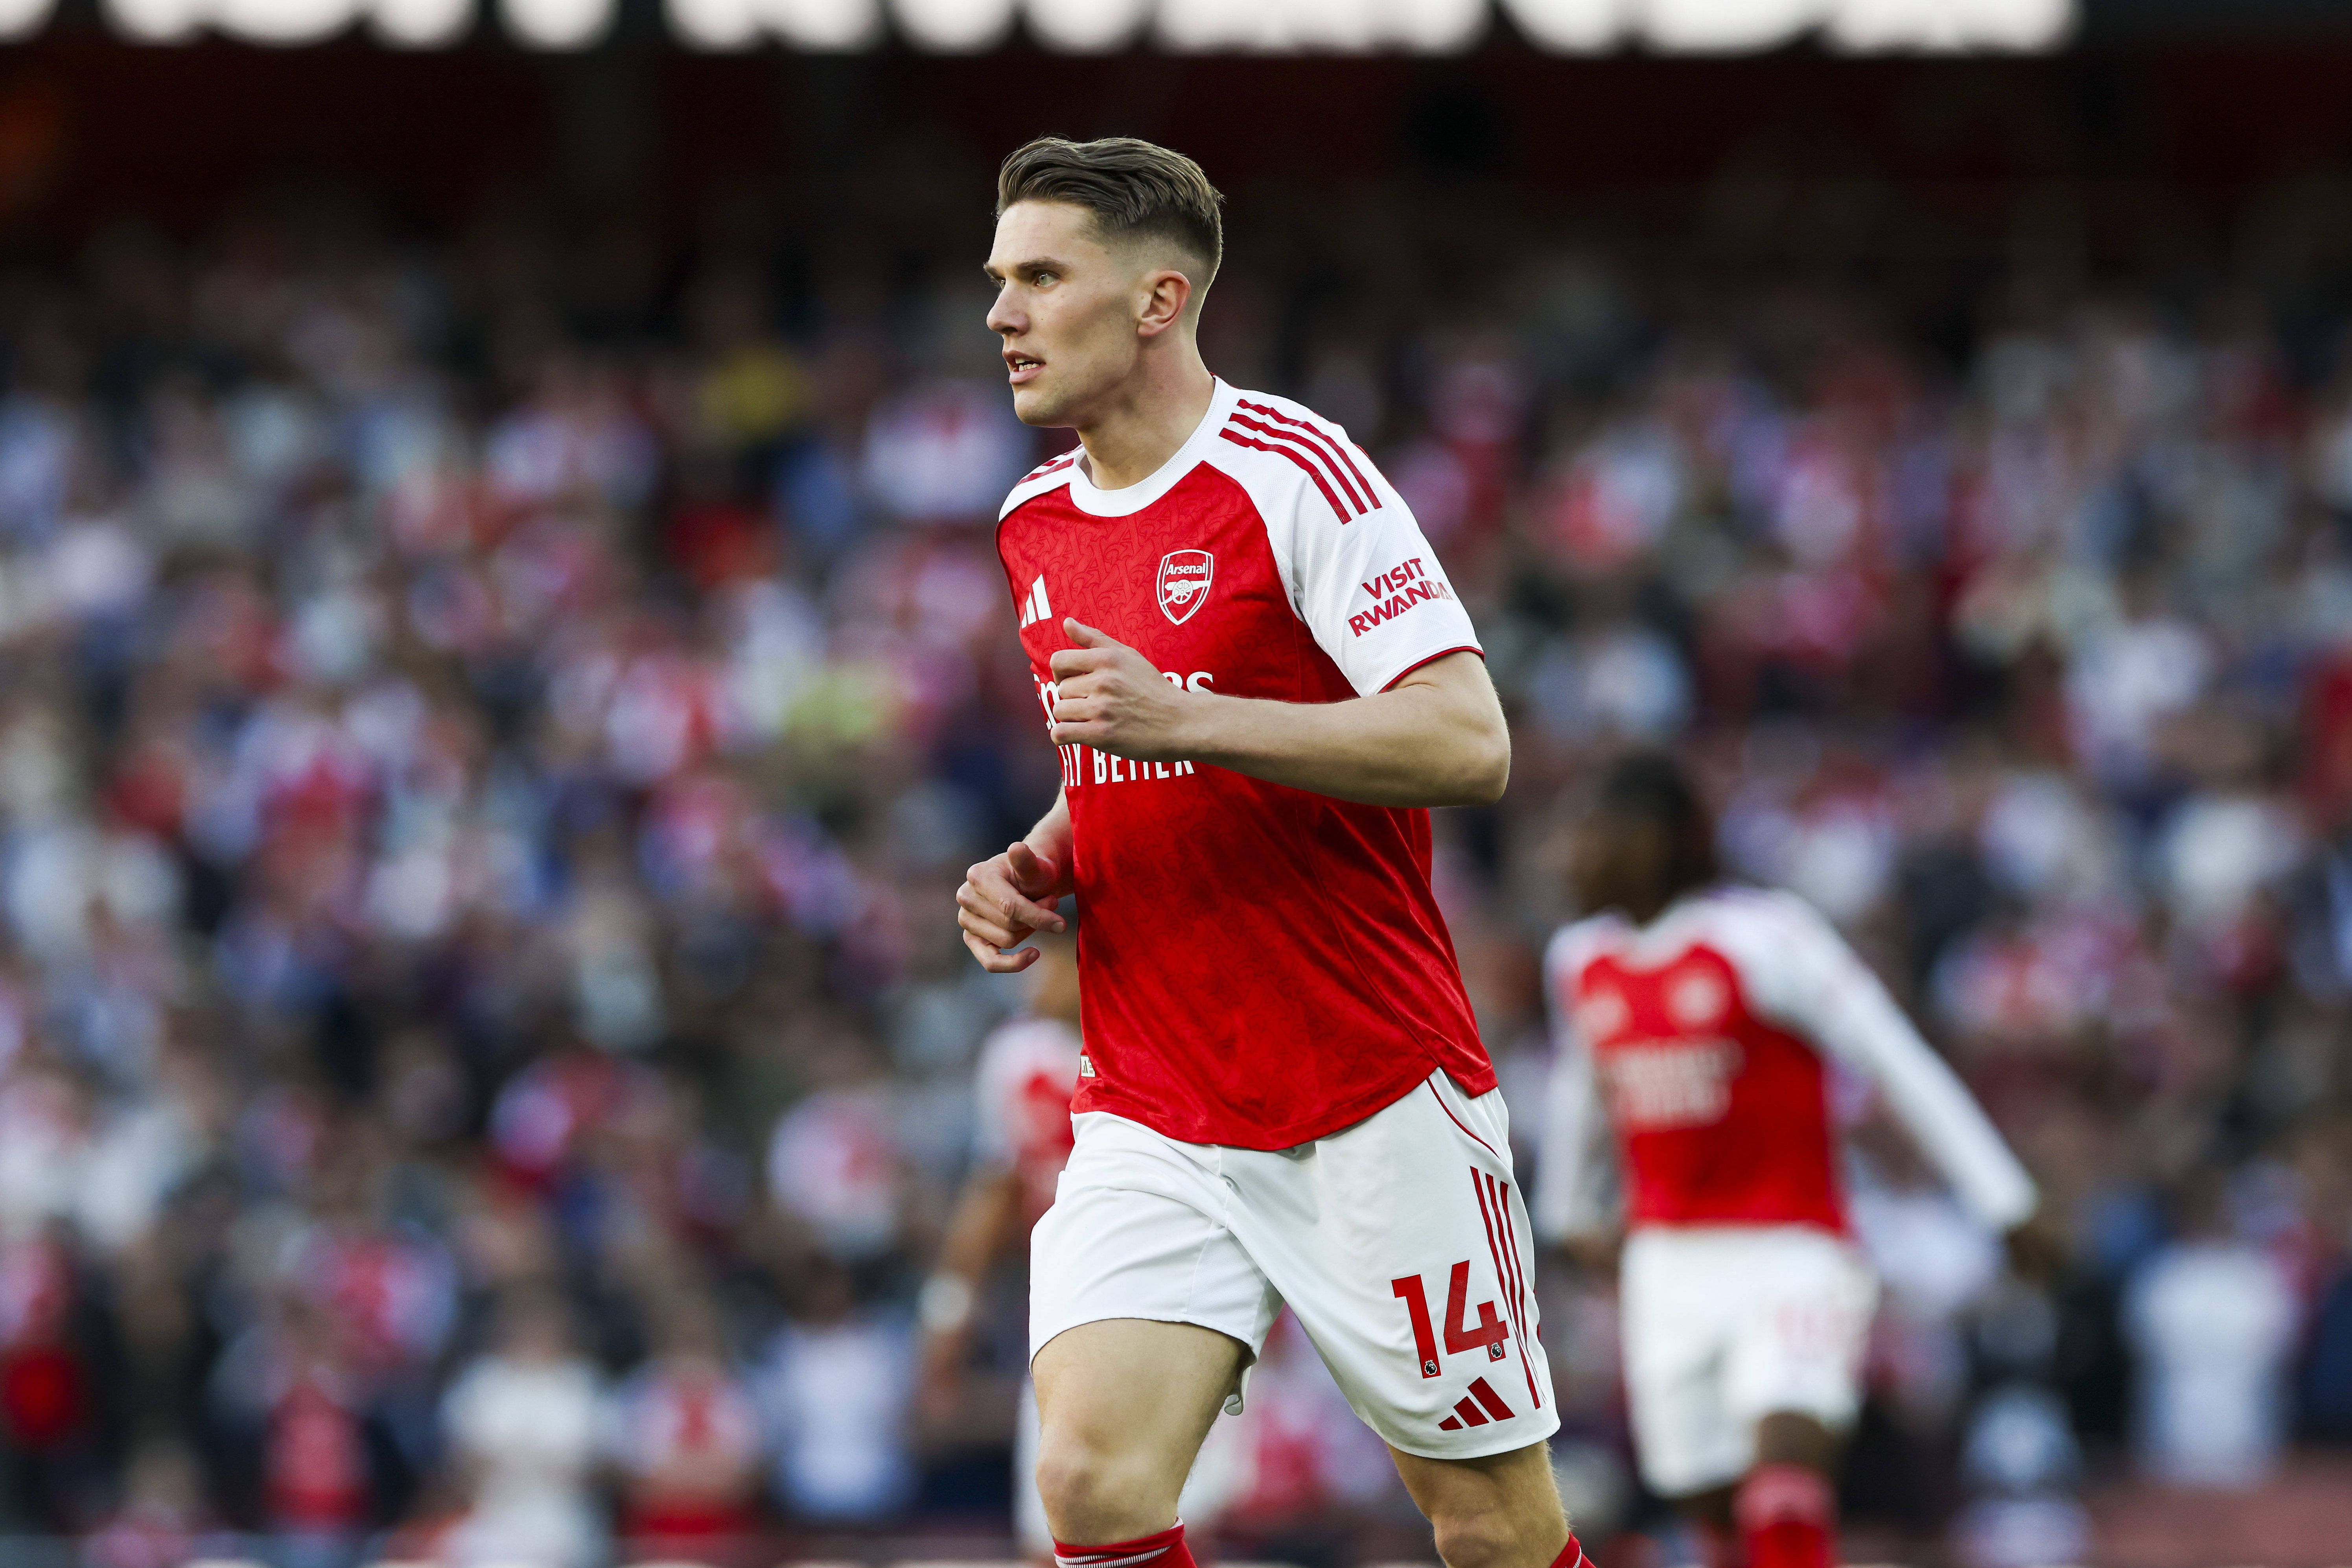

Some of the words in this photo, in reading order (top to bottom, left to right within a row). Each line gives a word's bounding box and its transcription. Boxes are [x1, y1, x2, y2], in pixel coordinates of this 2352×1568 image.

[1166, 563, 1206, 575] Arsenal
[1361, 558, 1425, 600] VISIT
[1348, 580, 1453, 638] RWANDA
[1391, 1259, 1510, 1379] 14
